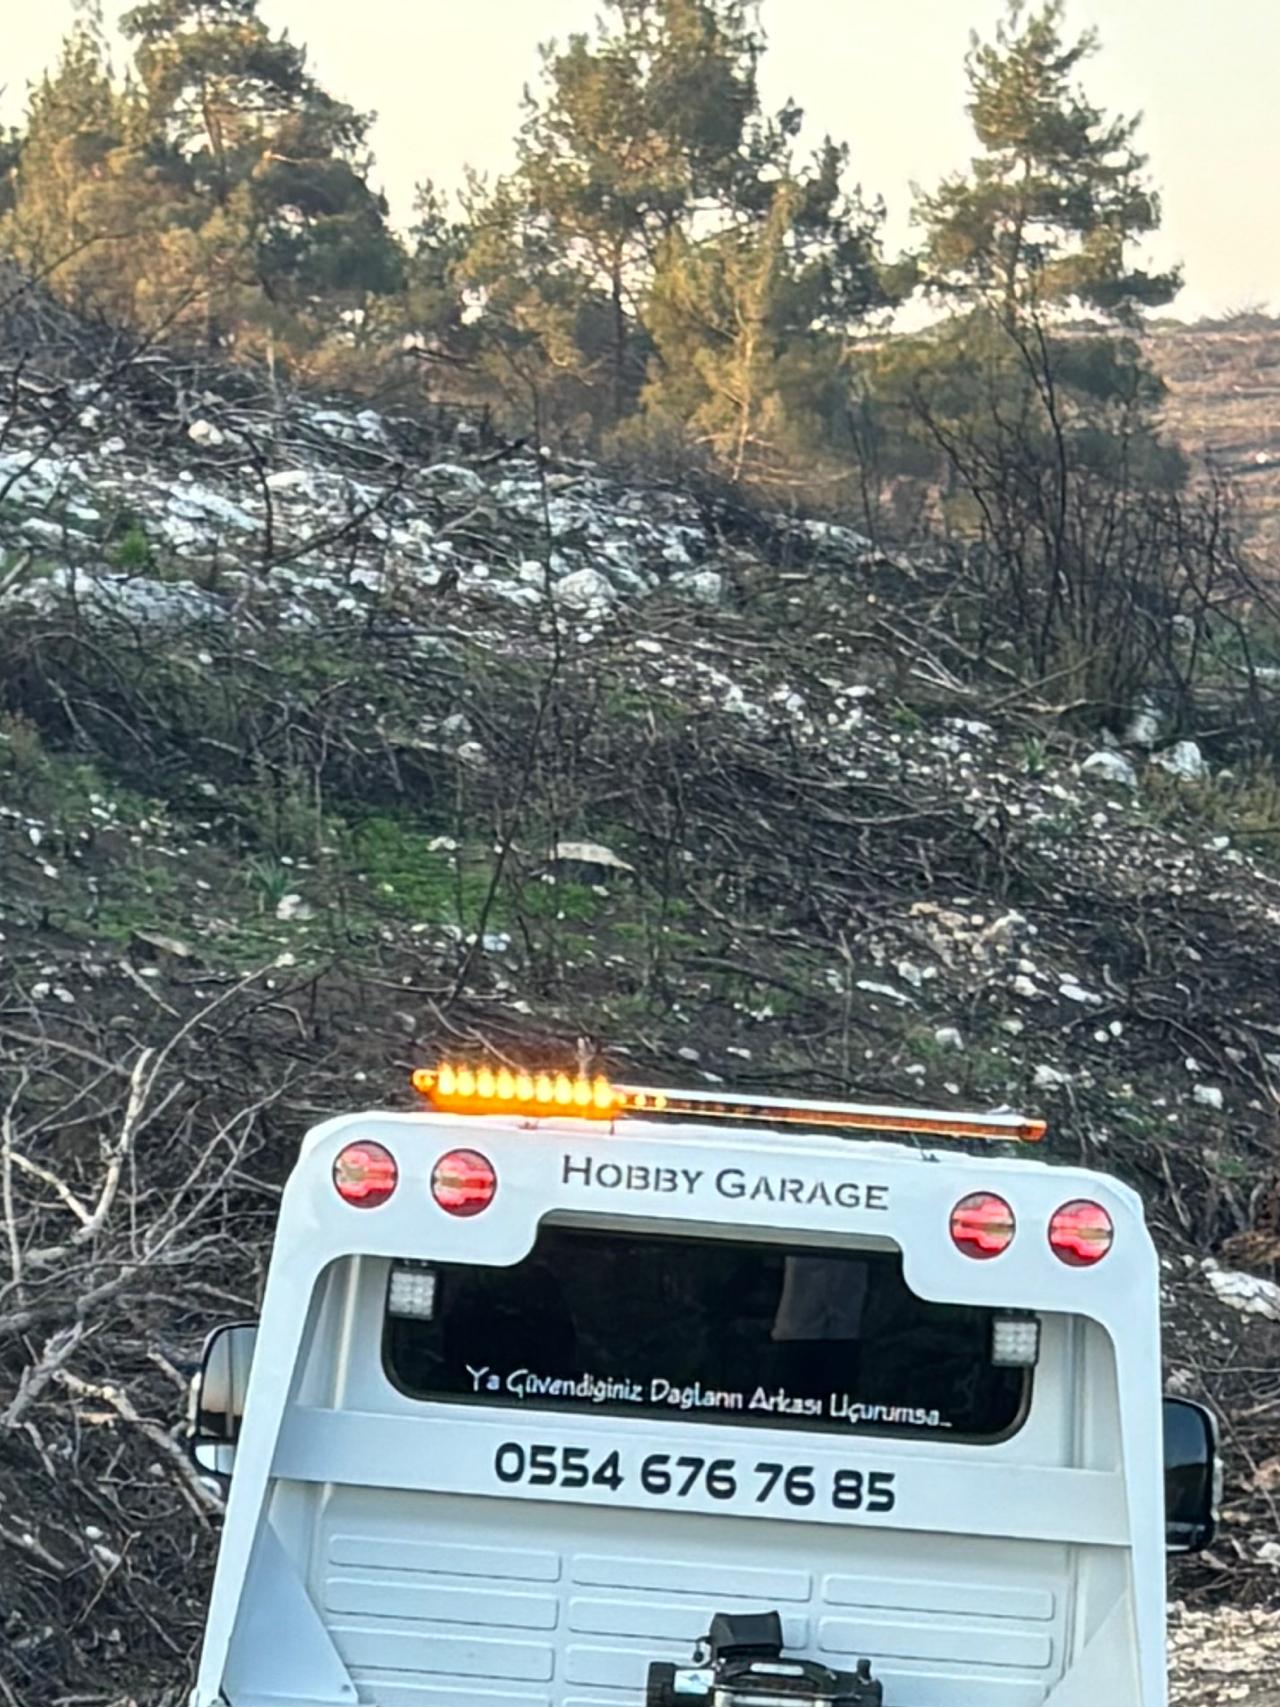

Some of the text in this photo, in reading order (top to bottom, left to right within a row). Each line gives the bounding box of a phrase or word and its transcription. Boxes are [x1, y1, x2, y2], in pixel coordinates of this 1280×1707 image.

[561, 1154, 890, 1212] HOBBY GARAGE
[465, 1364, 501, 1392] Ya
[493, 1441, 896, 1513] 0554 676 76 85
